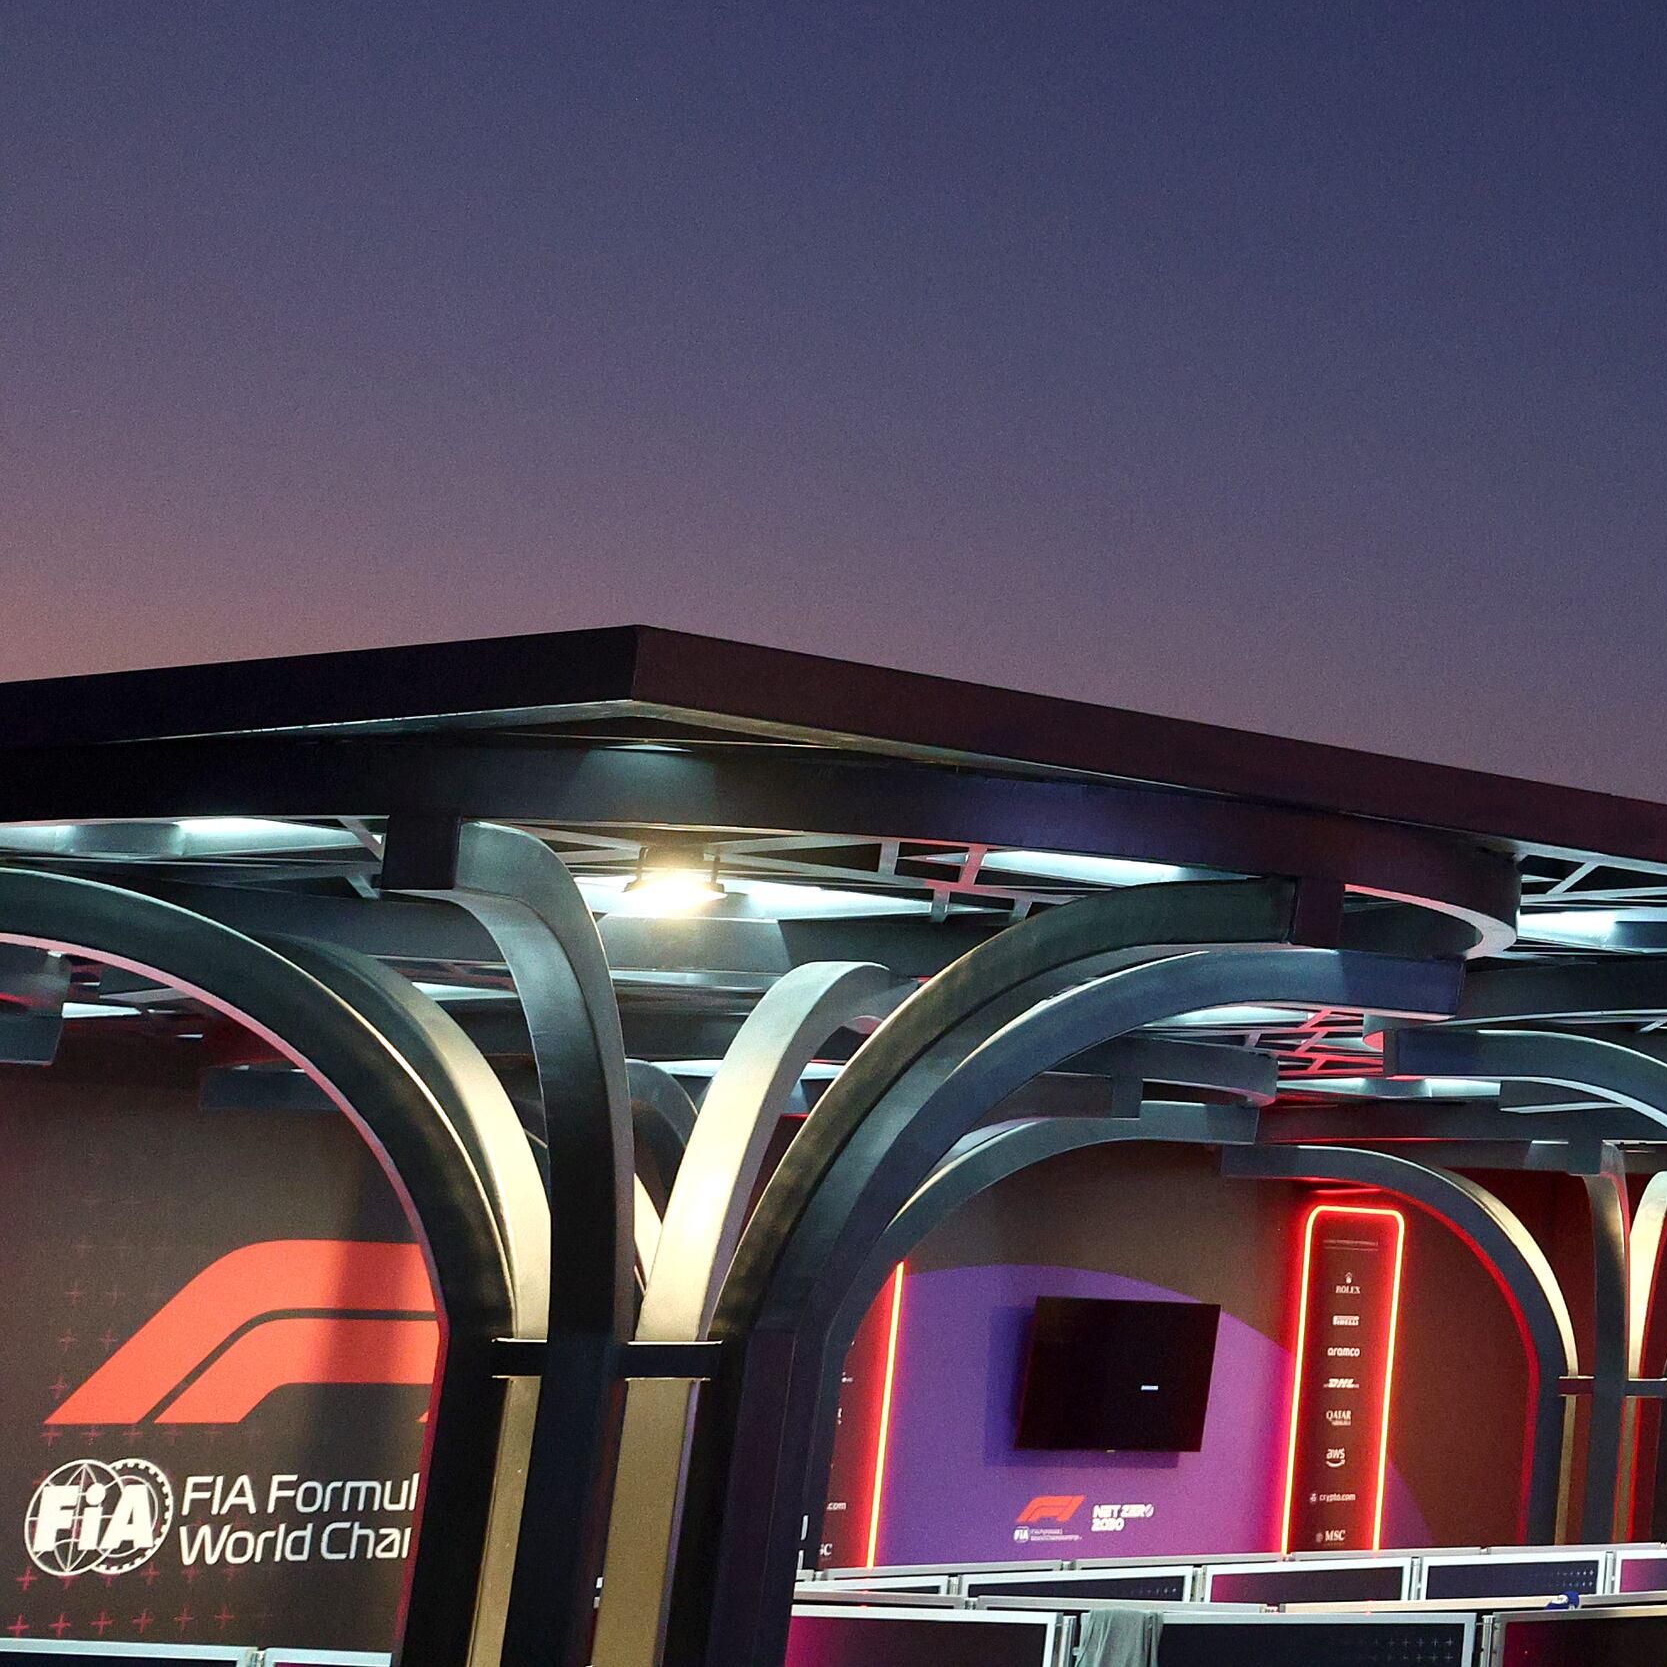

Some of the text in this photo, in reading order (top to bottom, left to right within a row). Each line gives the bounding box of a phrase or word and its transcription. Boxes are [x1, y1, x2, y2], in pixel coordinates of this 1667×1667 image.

[1335, 1285, 1360, 1294] ROLEX
[1327, 1347, 1361, 1357] aramco
[1326, 1378, 1357, 1388] DHL
[1326, 1410, 1351, 1421] QATAR
[1326, 1448, 1345, 1459] aws
[181, 1473, 419, 1515] FIA Formul
[1319, 1492, 1356, 1504] crypto.com
[1093, 1505, 1121, 1518] NET
[1121, 1504, 1154, 1518] ZERO
[1325, 1530, 1346, 1542] MSC
[180, 1521, 410, 1565] World Cha
